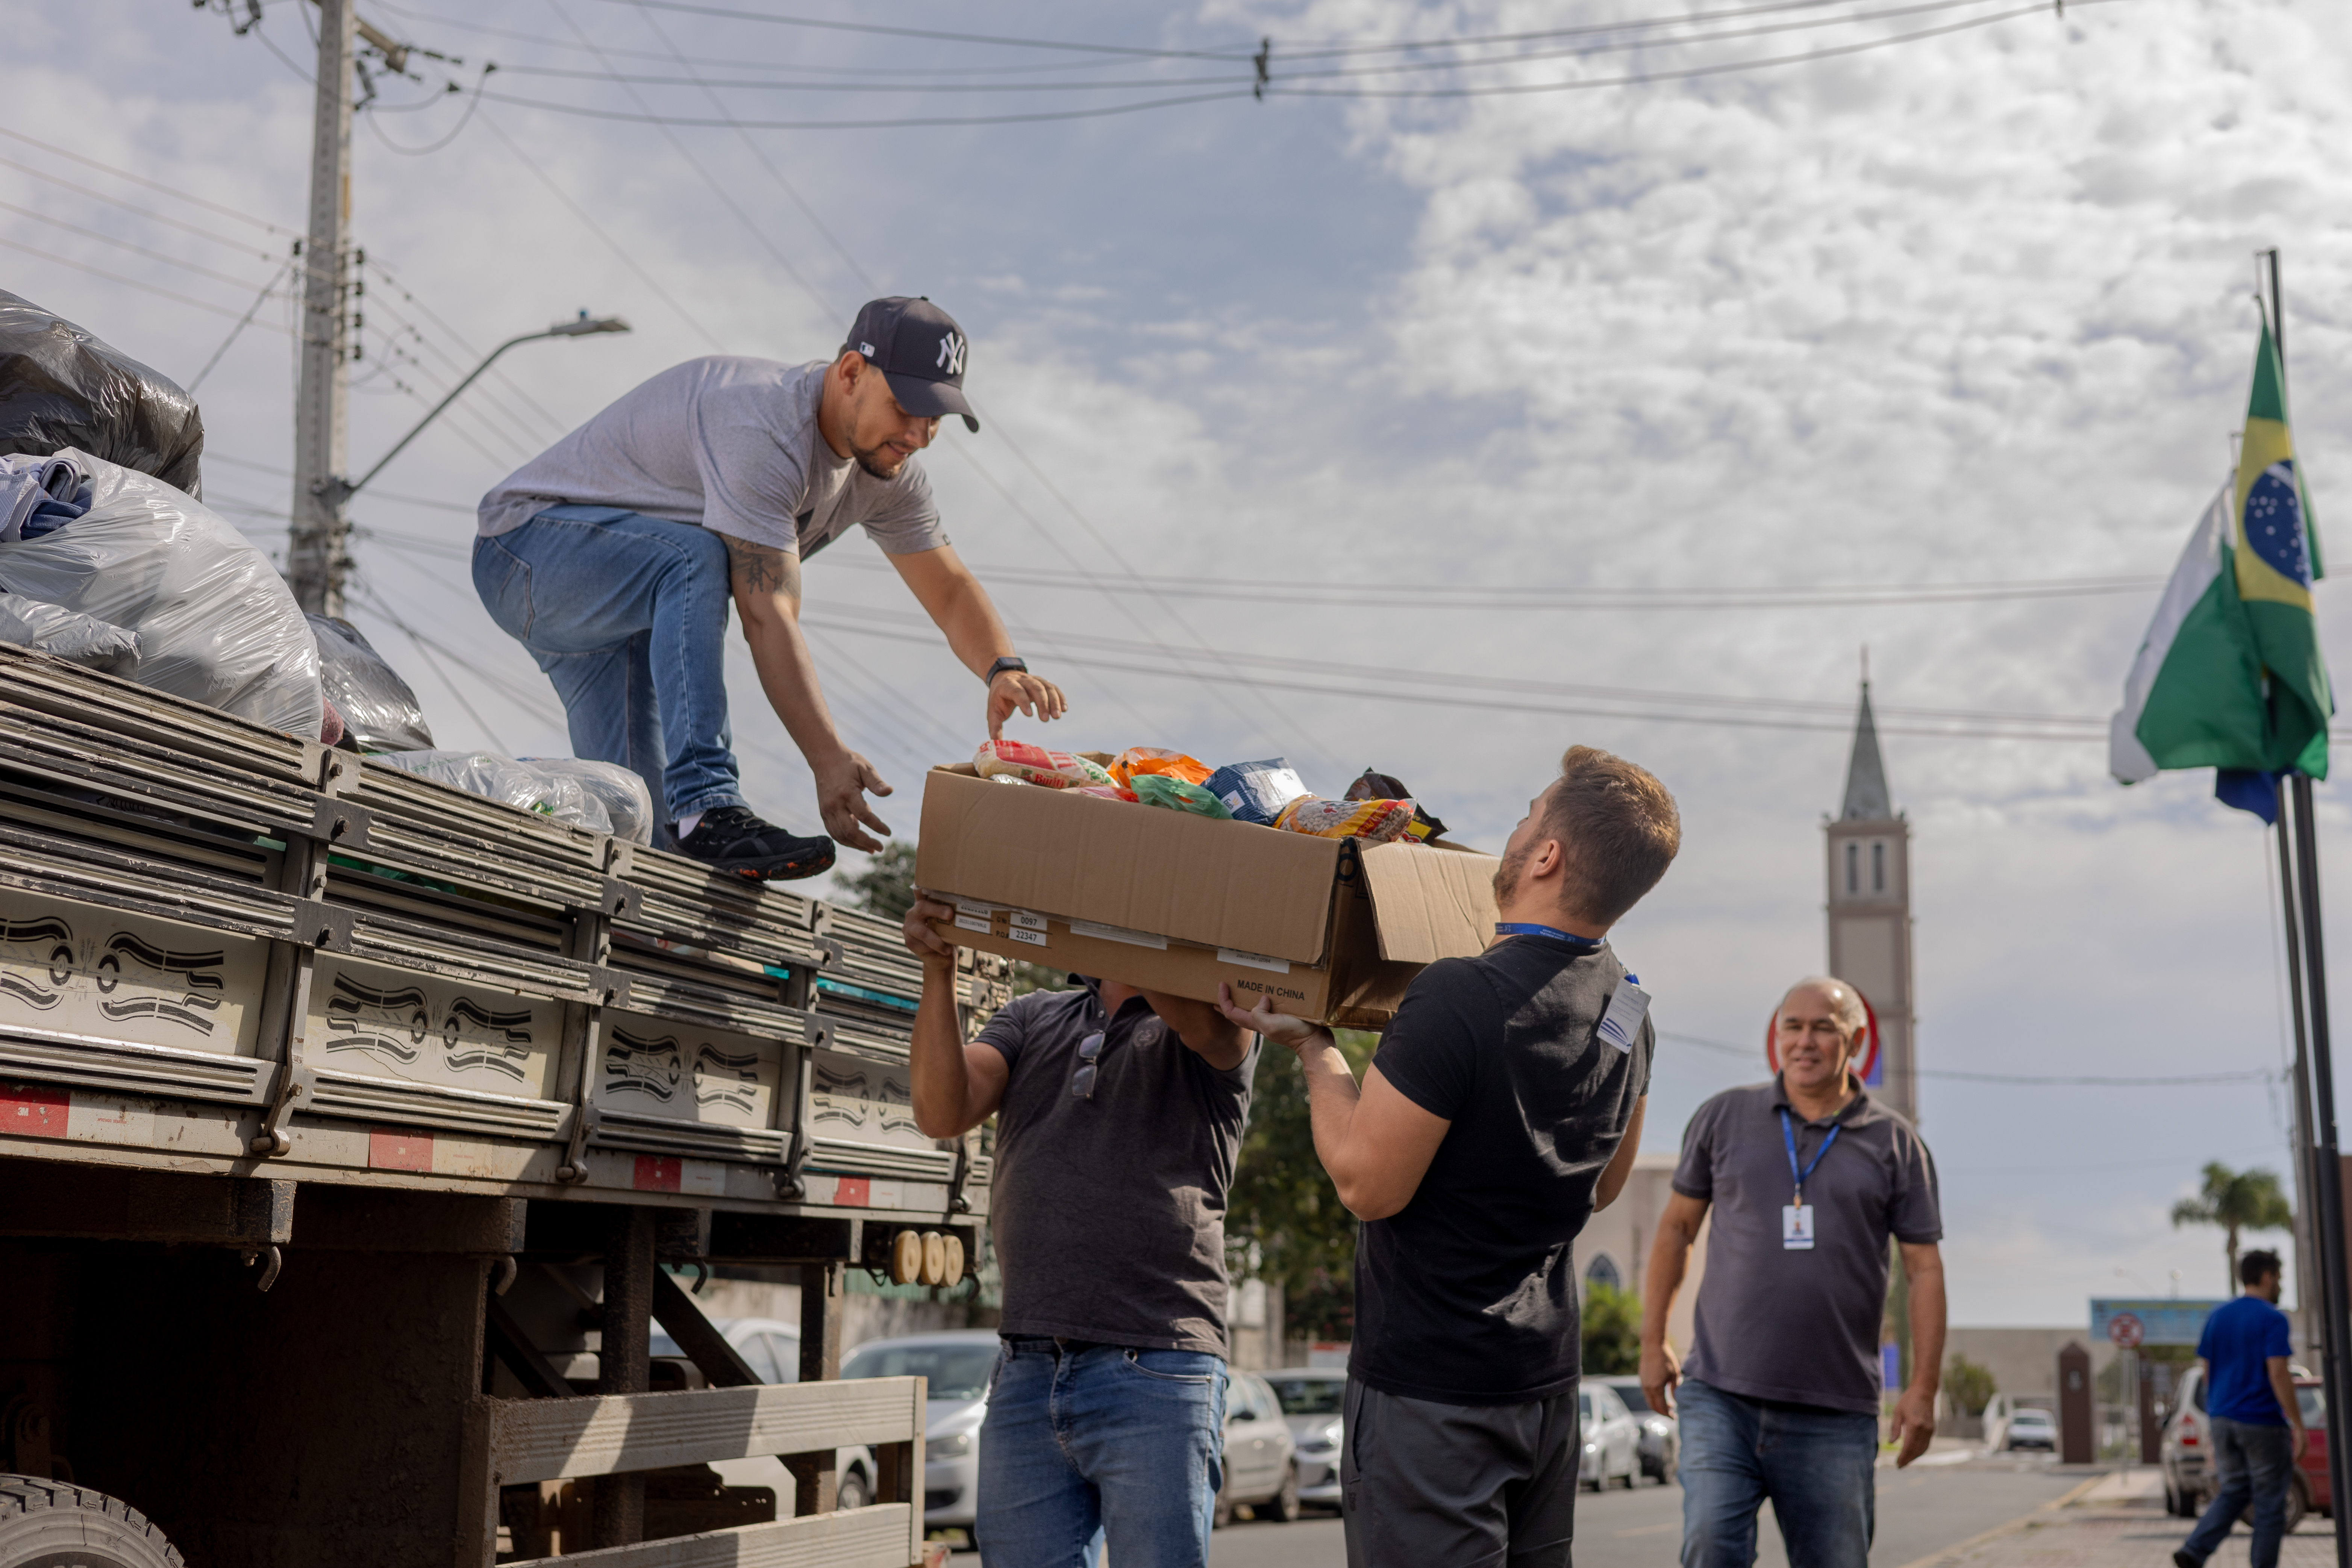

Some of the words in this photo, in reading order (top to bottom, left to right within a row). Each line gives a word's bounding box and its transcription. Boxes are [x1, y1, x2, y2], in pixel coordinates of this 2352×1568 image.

[1021, 917, 1037, 926] 0097
[1016, 930, 1037, 941] 22347
[1237, 980, 1263, 992] MADE
[1265, 985, 1274, 994] IN
[1277, 987, 1305, 1001] CHINA
[18, 1107, 29, 1117] 3M
